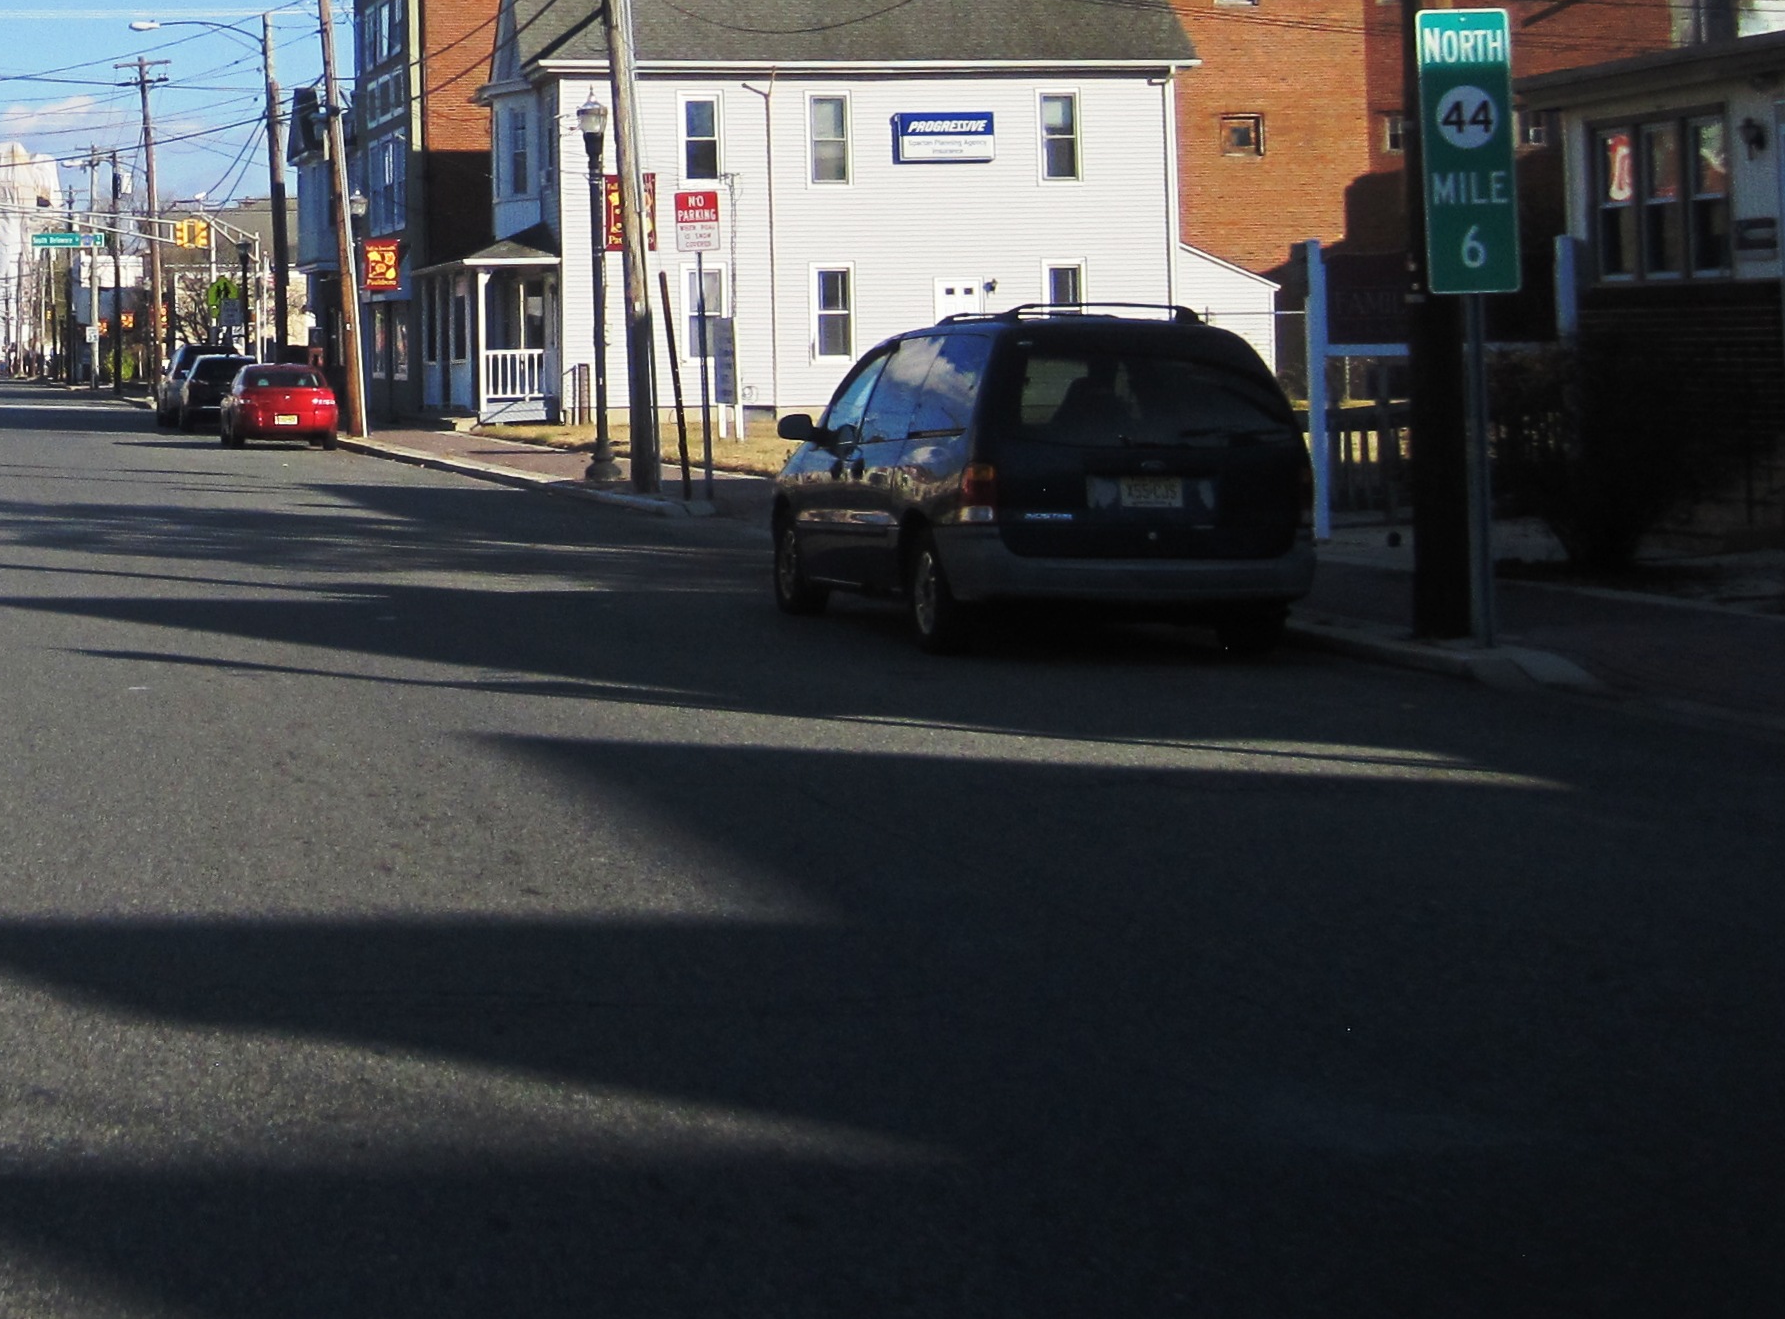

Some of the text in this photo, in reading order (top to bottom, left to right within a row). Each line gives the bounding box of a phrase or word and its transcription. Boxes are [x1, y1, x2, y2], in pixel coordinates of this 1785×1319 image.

[1423, 27, 1503, 63] NORTH
[907, 119, 987, 133] PROGRESSIVE
[1441, 100, 1493, 134] 44
[688, 195, 705, 207] NO
[1431, 170, 1510, 204] MILE
[677, 209, 717, 221] PARKING
[1461, 225, 1487, 268] 6
